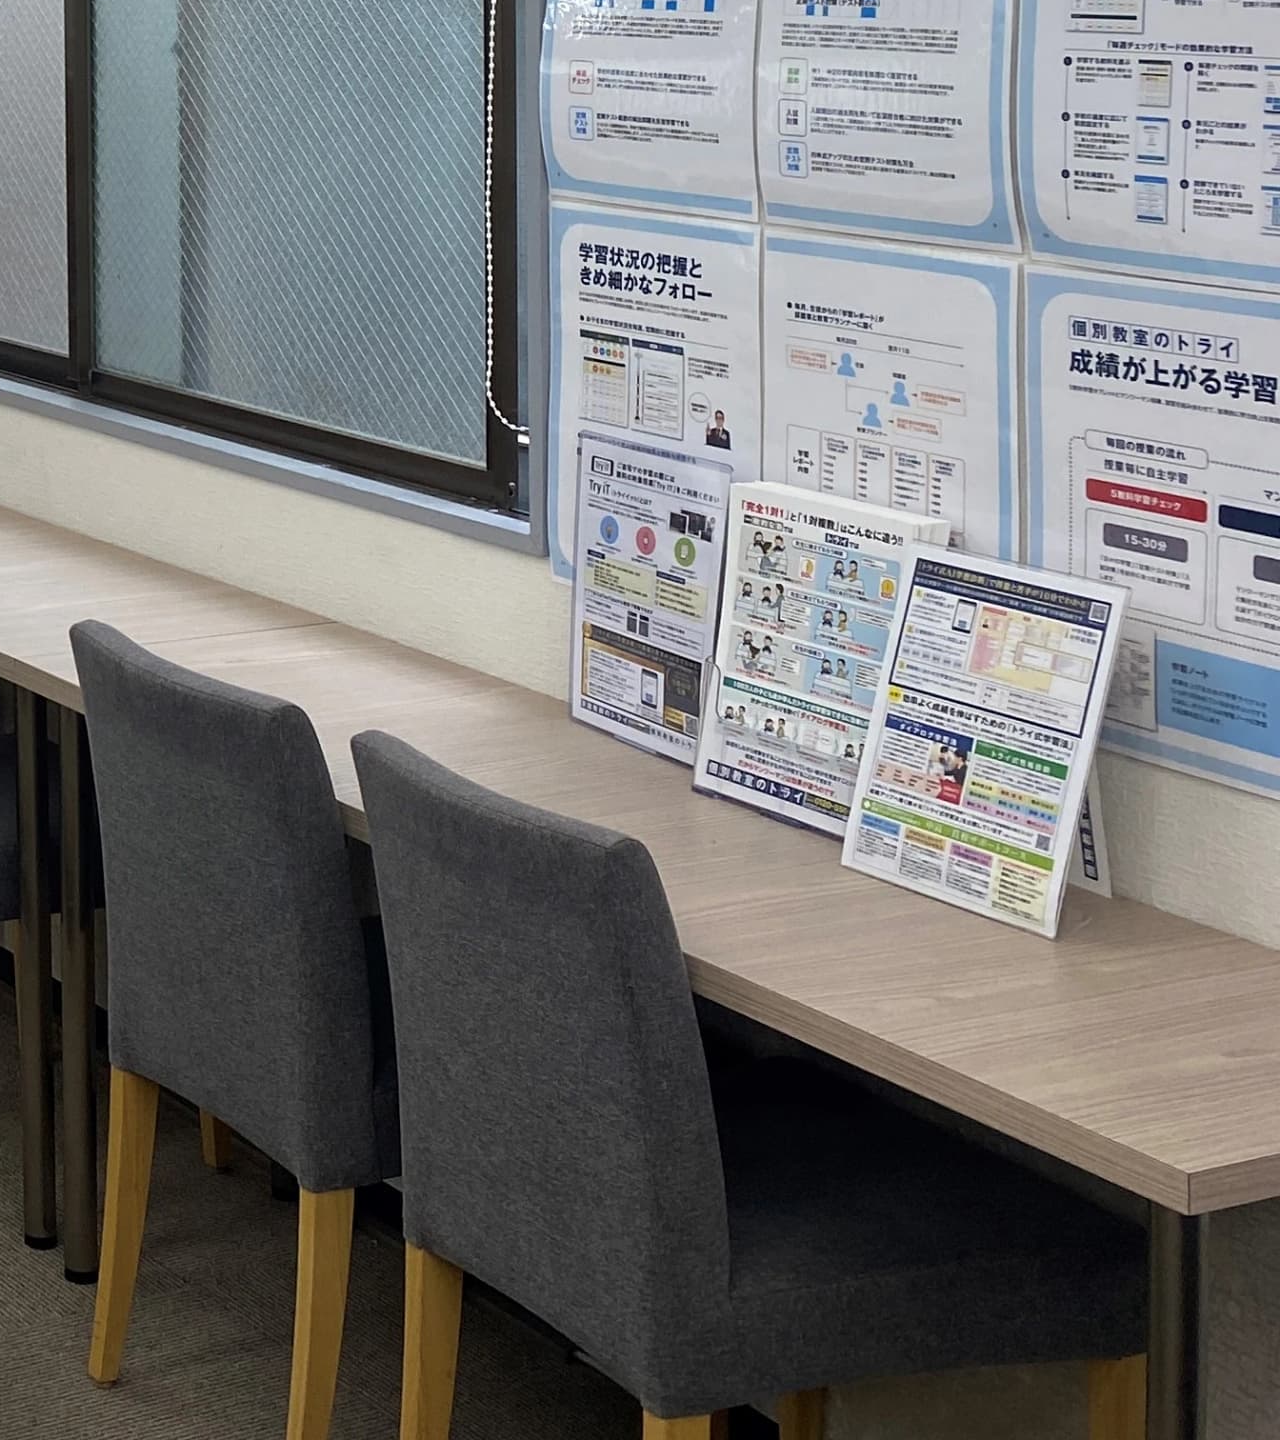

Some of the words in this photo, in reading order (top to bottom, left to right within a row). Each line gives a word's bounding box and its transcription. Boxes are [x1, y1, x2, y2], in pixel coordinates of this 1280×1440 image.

[579, 242, 703, 279] 学習状況の把握と
[580, 265, 713, 301] きめ細かなフォロー
[1071, 320, 1234, 359] 個別教室のトライ
[1069, 348, 1279, 406] 成績が上がる学習
[708, 761, 804, 805] 個別教室のトライ
